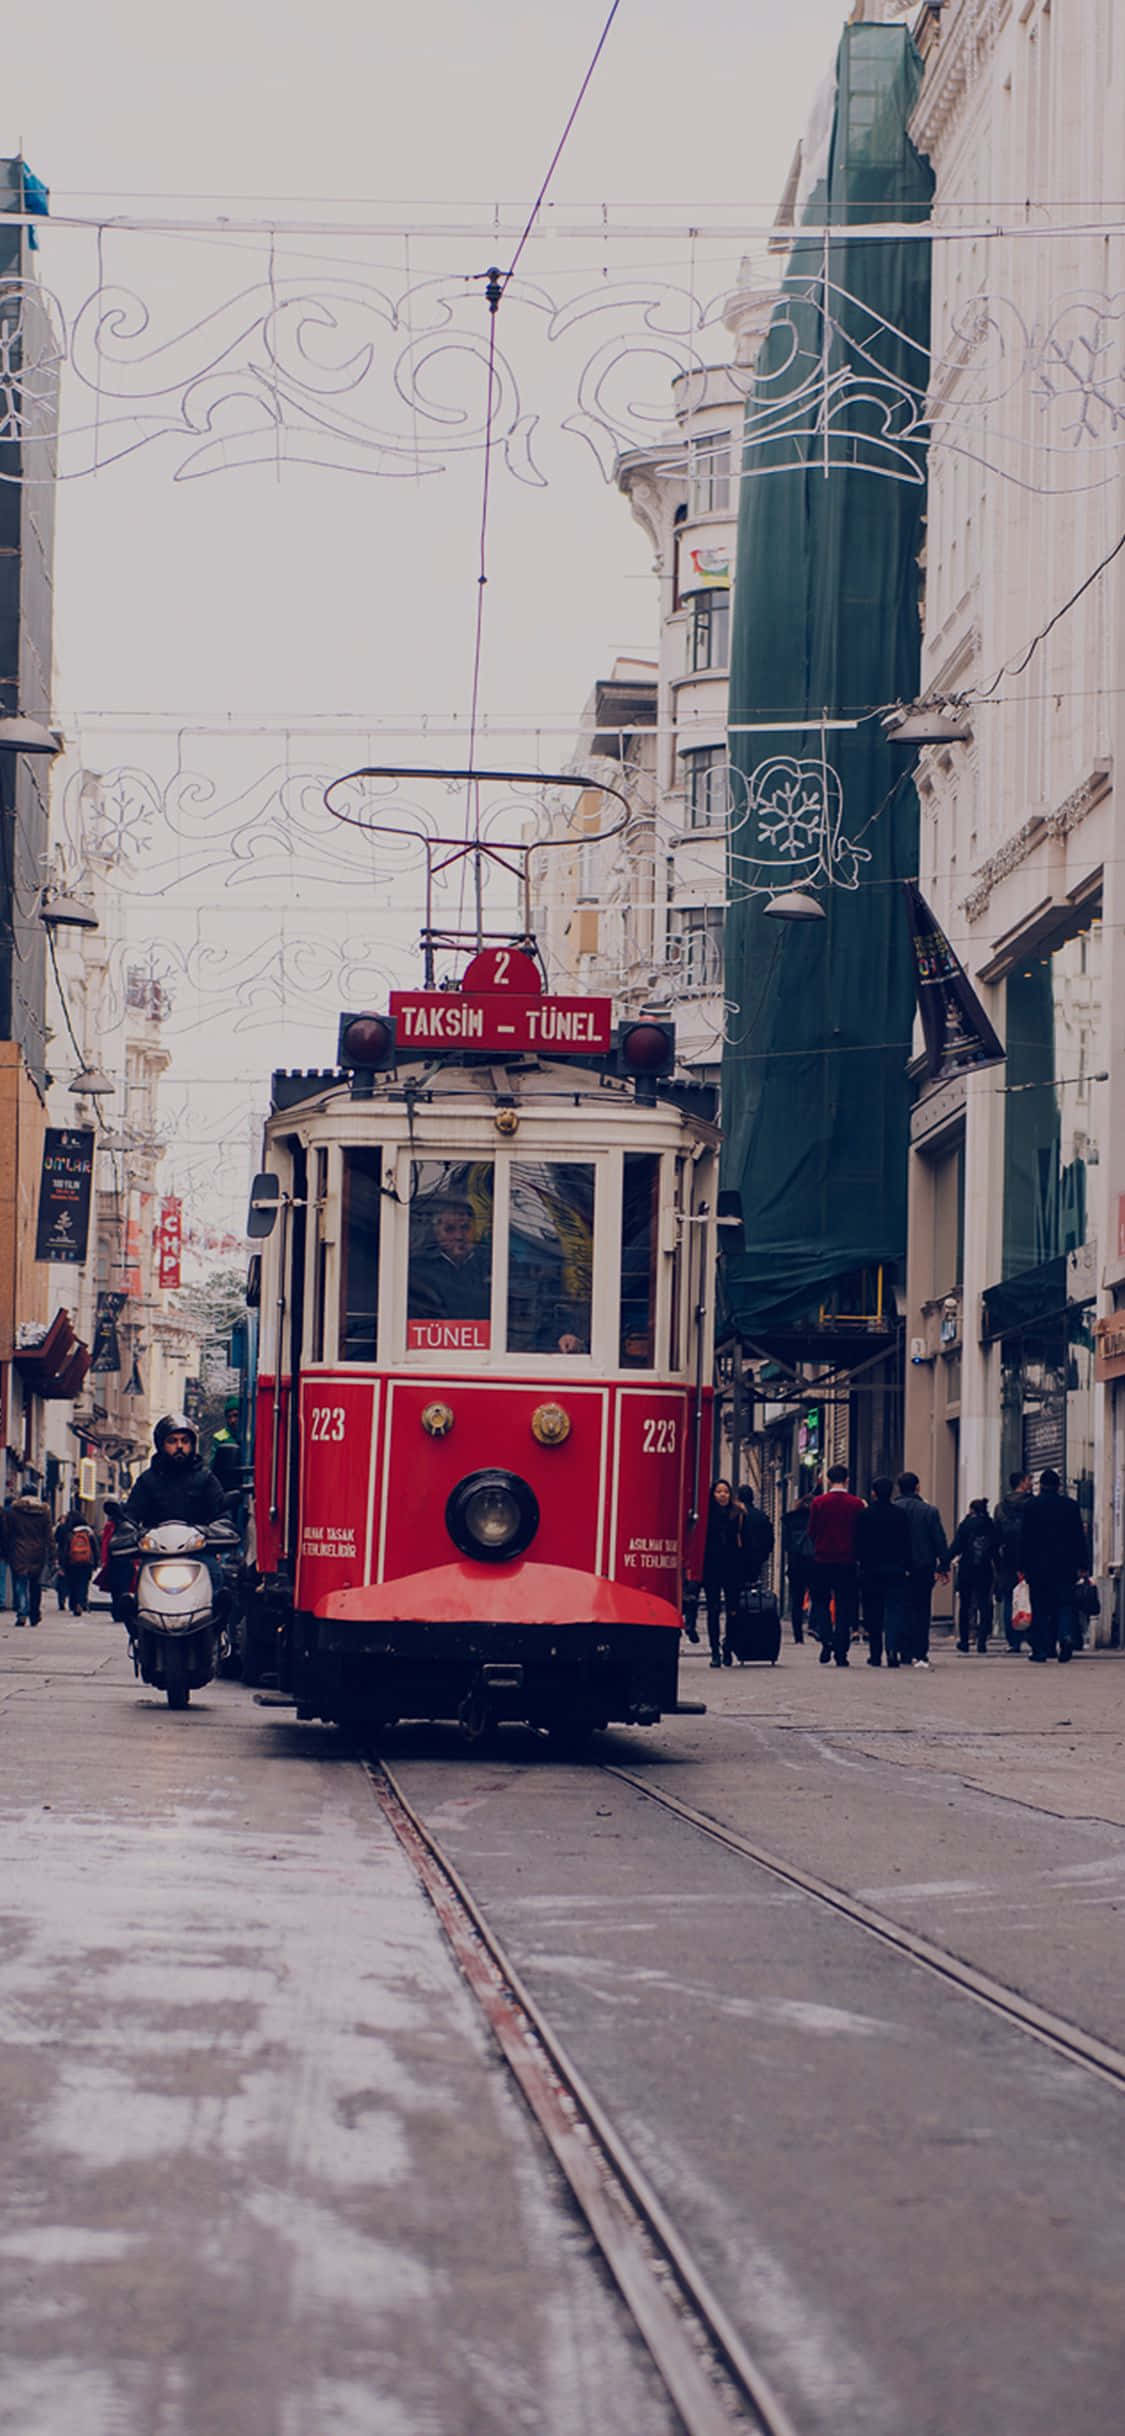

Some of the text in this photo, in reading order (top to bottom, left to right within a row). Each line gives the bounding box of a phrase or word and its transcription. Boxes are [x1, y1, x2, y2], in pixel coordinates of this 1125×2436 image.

[494, 951, 510, 985] 2
[401, 1003, 484, 1038] TAKSİM
[526, 1006, 603, 1041] TÜNEL
[163, 1215, 179, 1273] CHP
[413, 1324, 485, 1347] TÜNEL
[311, 1407, 345, 1441] 223
[642, 1418, 676, 1453] 223
[326, 1527, 355, 1542] YASAK
[623, 1553, 637, 1568] VE
